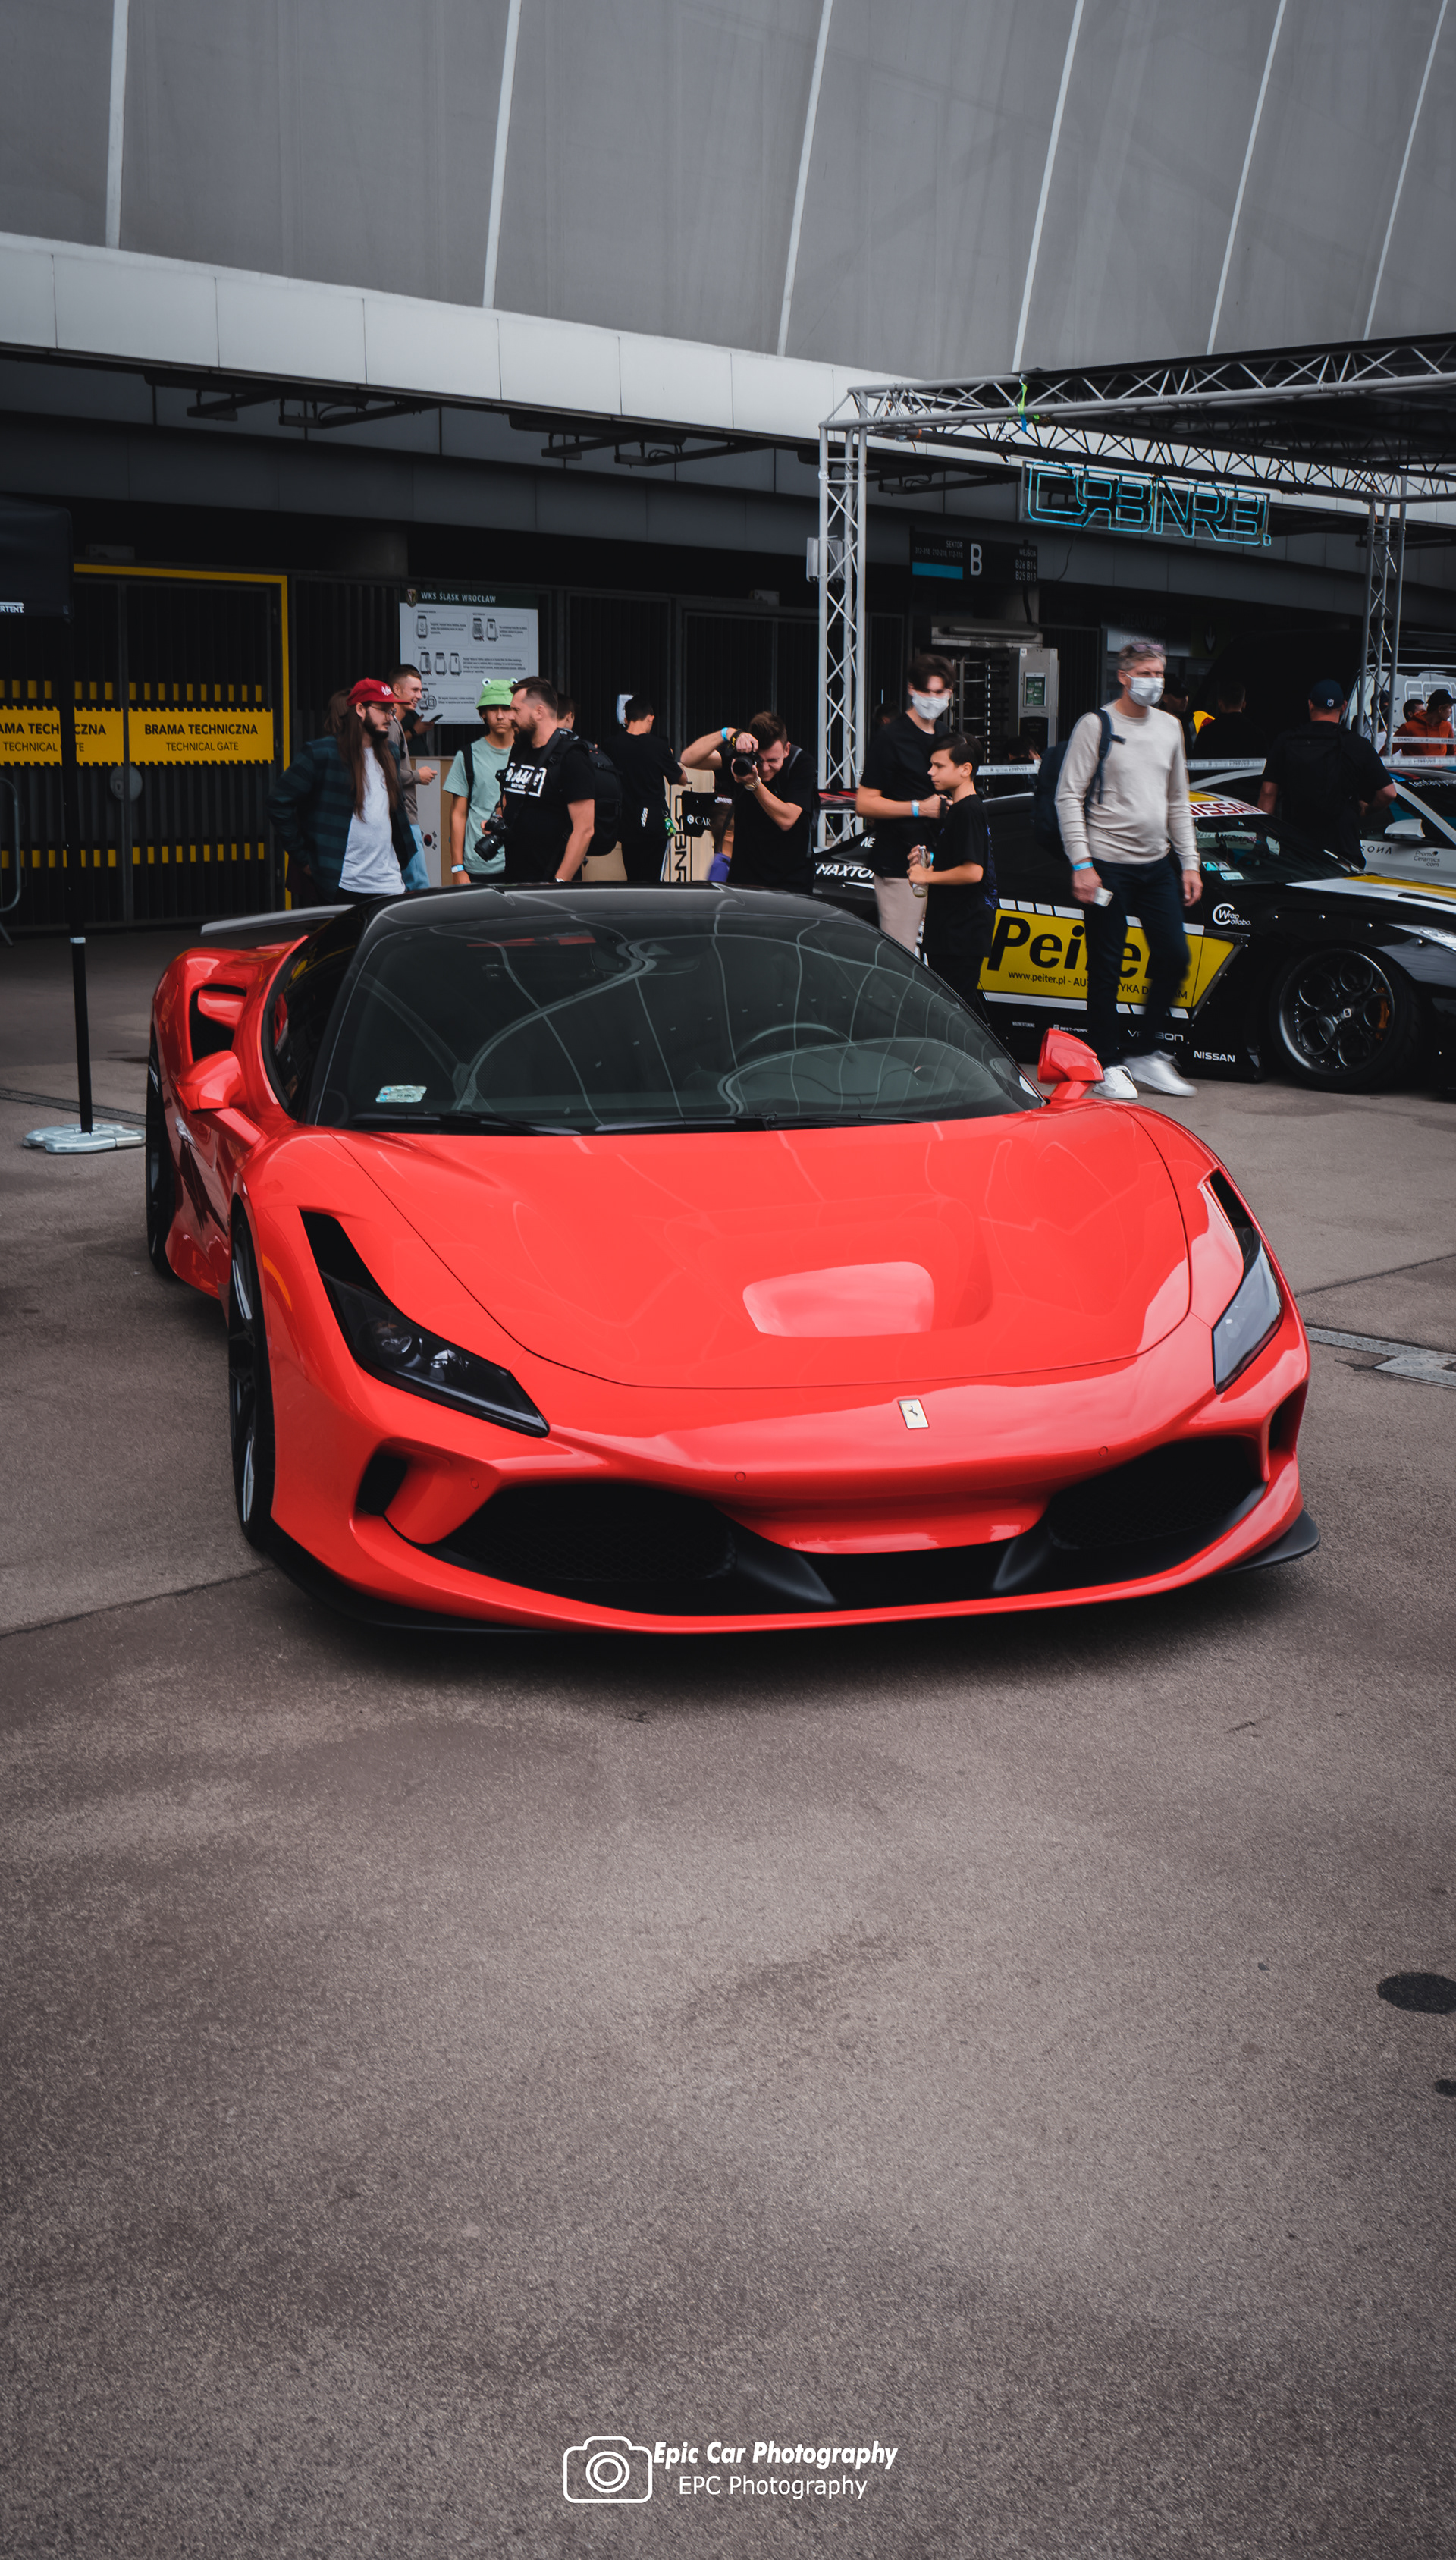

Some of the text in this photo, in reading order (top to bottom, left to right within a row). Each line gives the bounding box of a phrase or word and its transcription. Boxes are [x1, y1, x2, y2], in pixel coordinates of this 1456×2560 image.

[946, 539, 963, 549] SEKTOR
[970, 542, 983, 576] B
[421, 591, 497, 604] WKS ŚLĄSK WROCŁAW
[28, 723, 107, 735] TECHCZNA
[144, 724, 259, 735] BRAMA TECHNICZNA
[3, 741, 58, 752] TECHNICAL
[166, 742, 239, 752] TECHNICAL GATE
[1008, 972, 1066, 985] www.peiter.pl
[1194, 1050, 1236, 1063] NISSAN
